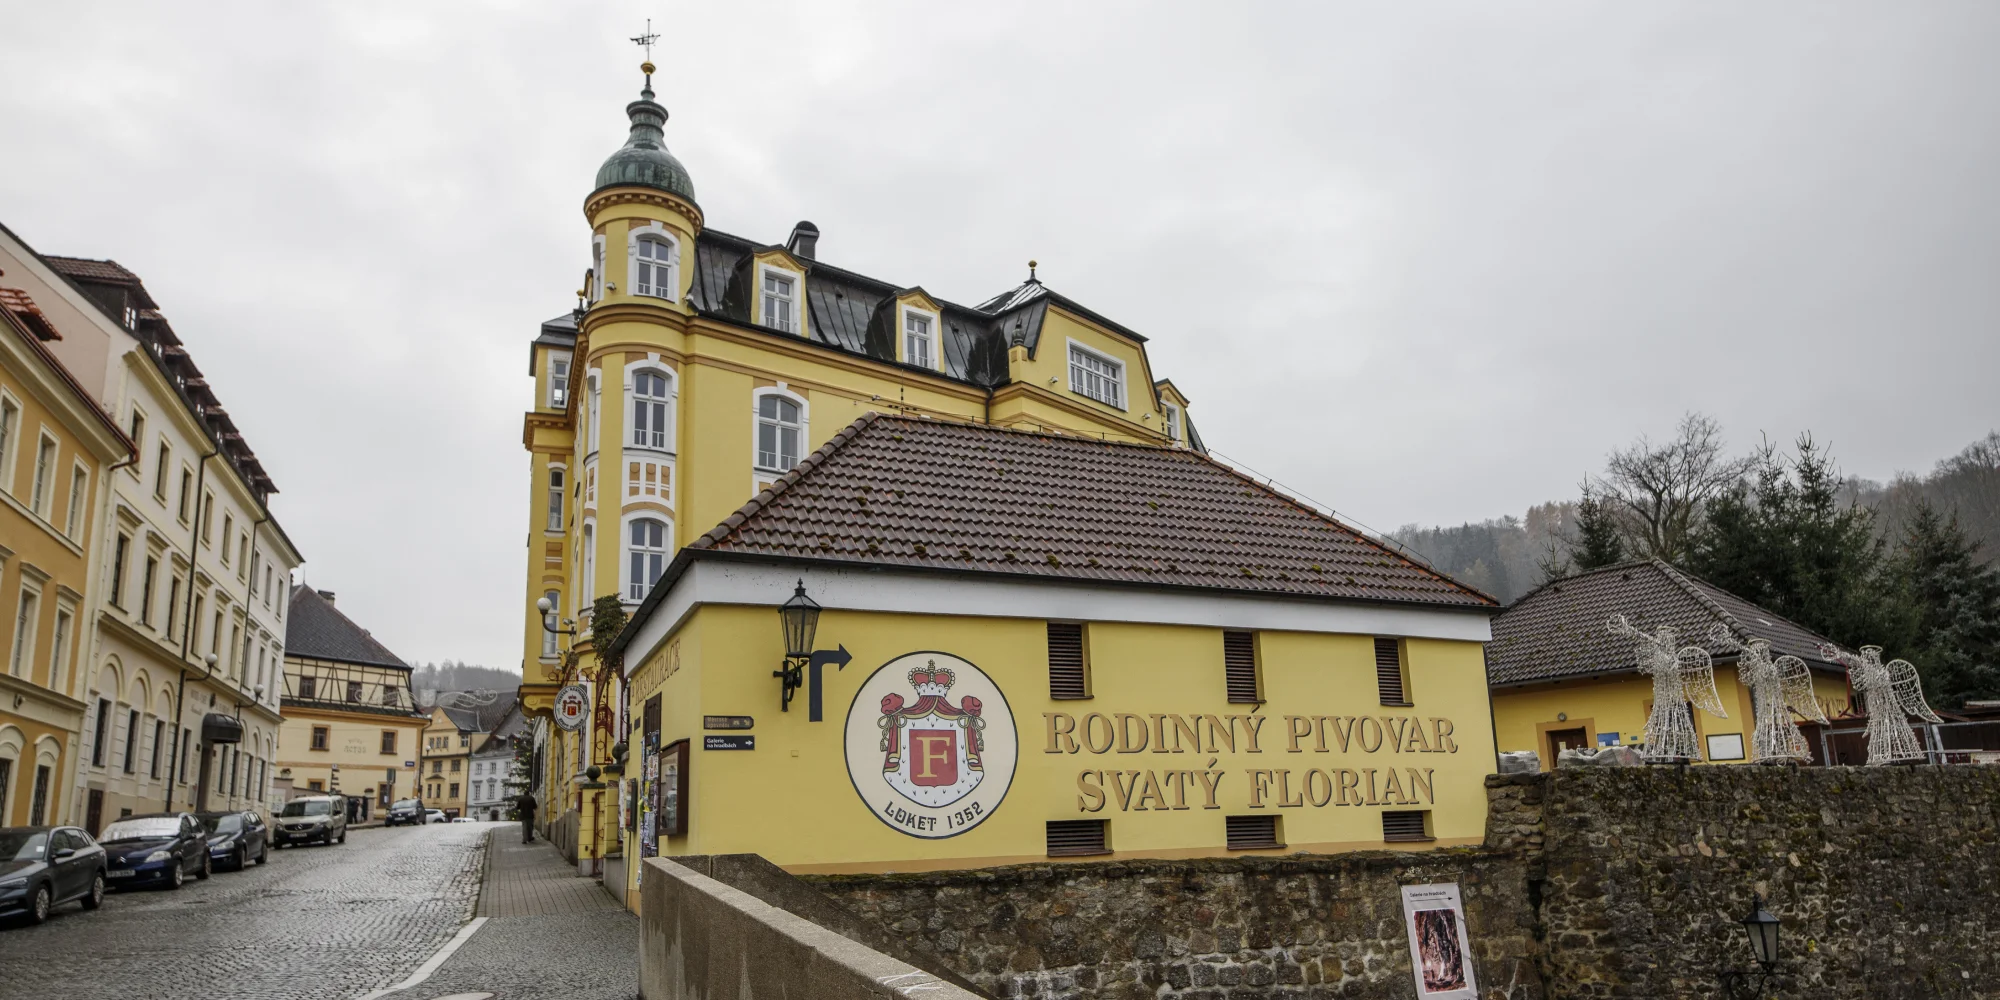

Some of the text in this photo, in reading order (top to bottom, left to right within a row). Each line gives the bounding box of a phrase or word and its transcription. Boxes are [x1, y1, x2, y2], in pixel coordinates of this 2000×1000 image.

[1042, 704, 1459, 755] RODINNÝ PIVOVAR
[916, 736, 951, 778] F
[1076, 757, 1435, 813] SVATÝ FLORIAN
[884, 801, 984, 832] LOKET 1352
